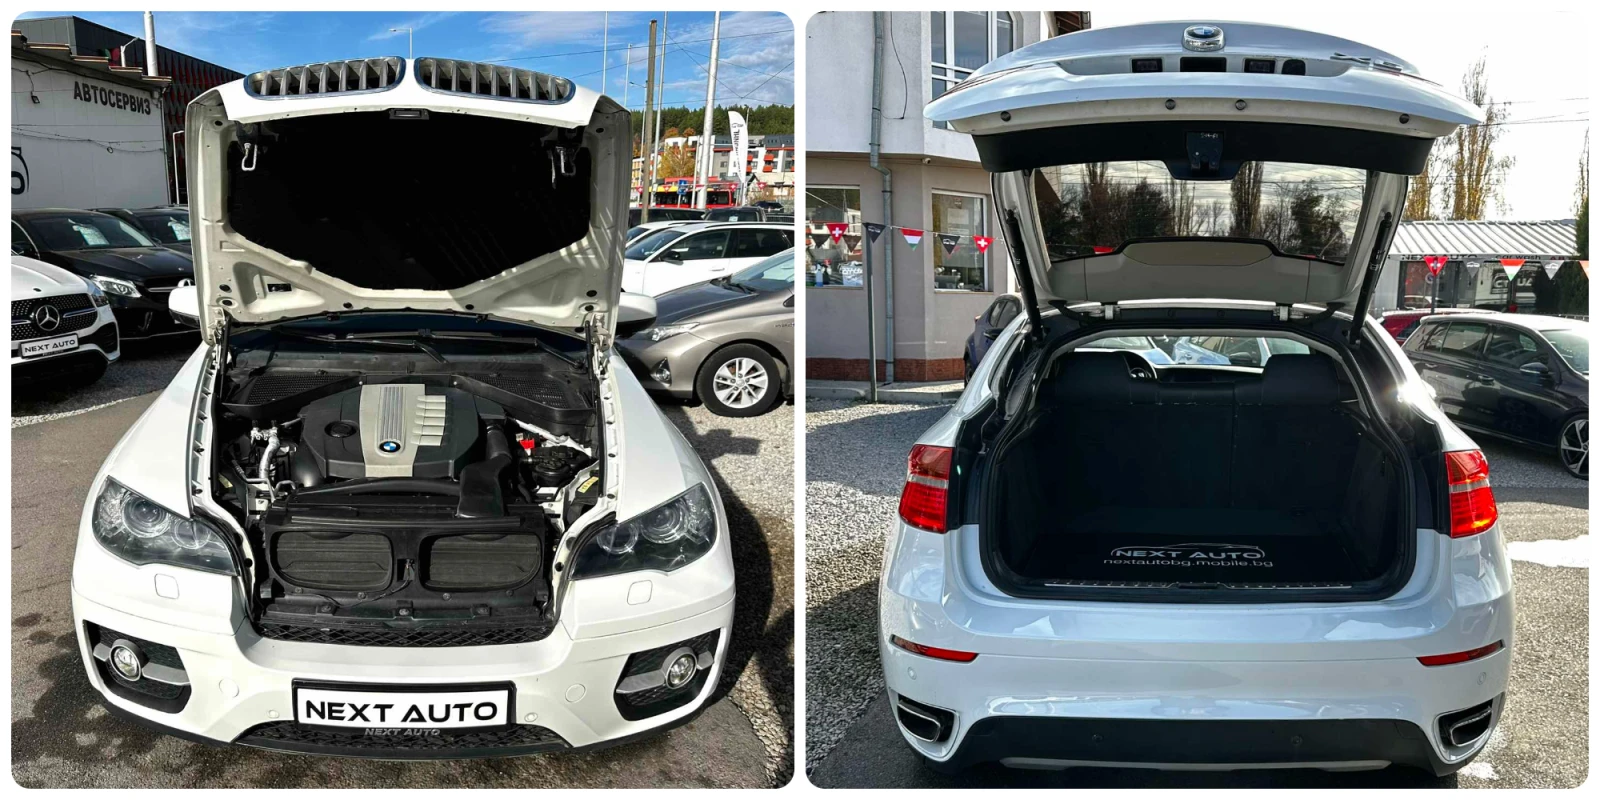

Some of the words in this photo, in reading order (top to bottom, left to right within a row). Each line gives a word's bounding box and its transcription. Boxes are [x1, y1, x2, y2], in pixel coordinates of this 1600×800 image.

[73, 81, 152, 115] АВТОСЕРВИЗ
[24, 343, 50, 353] NEXT
[52, 339, 76, 349] AUTO
[1115, 550, 1181, 558] NEXT
[1188, 551, 1262, 559] AUTO
[1104, 559, 1273, 568] nextautobg.mobile.bg
[305, 699, 394, 723] NEXT
[400, 701, 498, 723] AUTO
[364, 728, 401, 736] NEXT
[404, 728, 440, 736] AUTO
